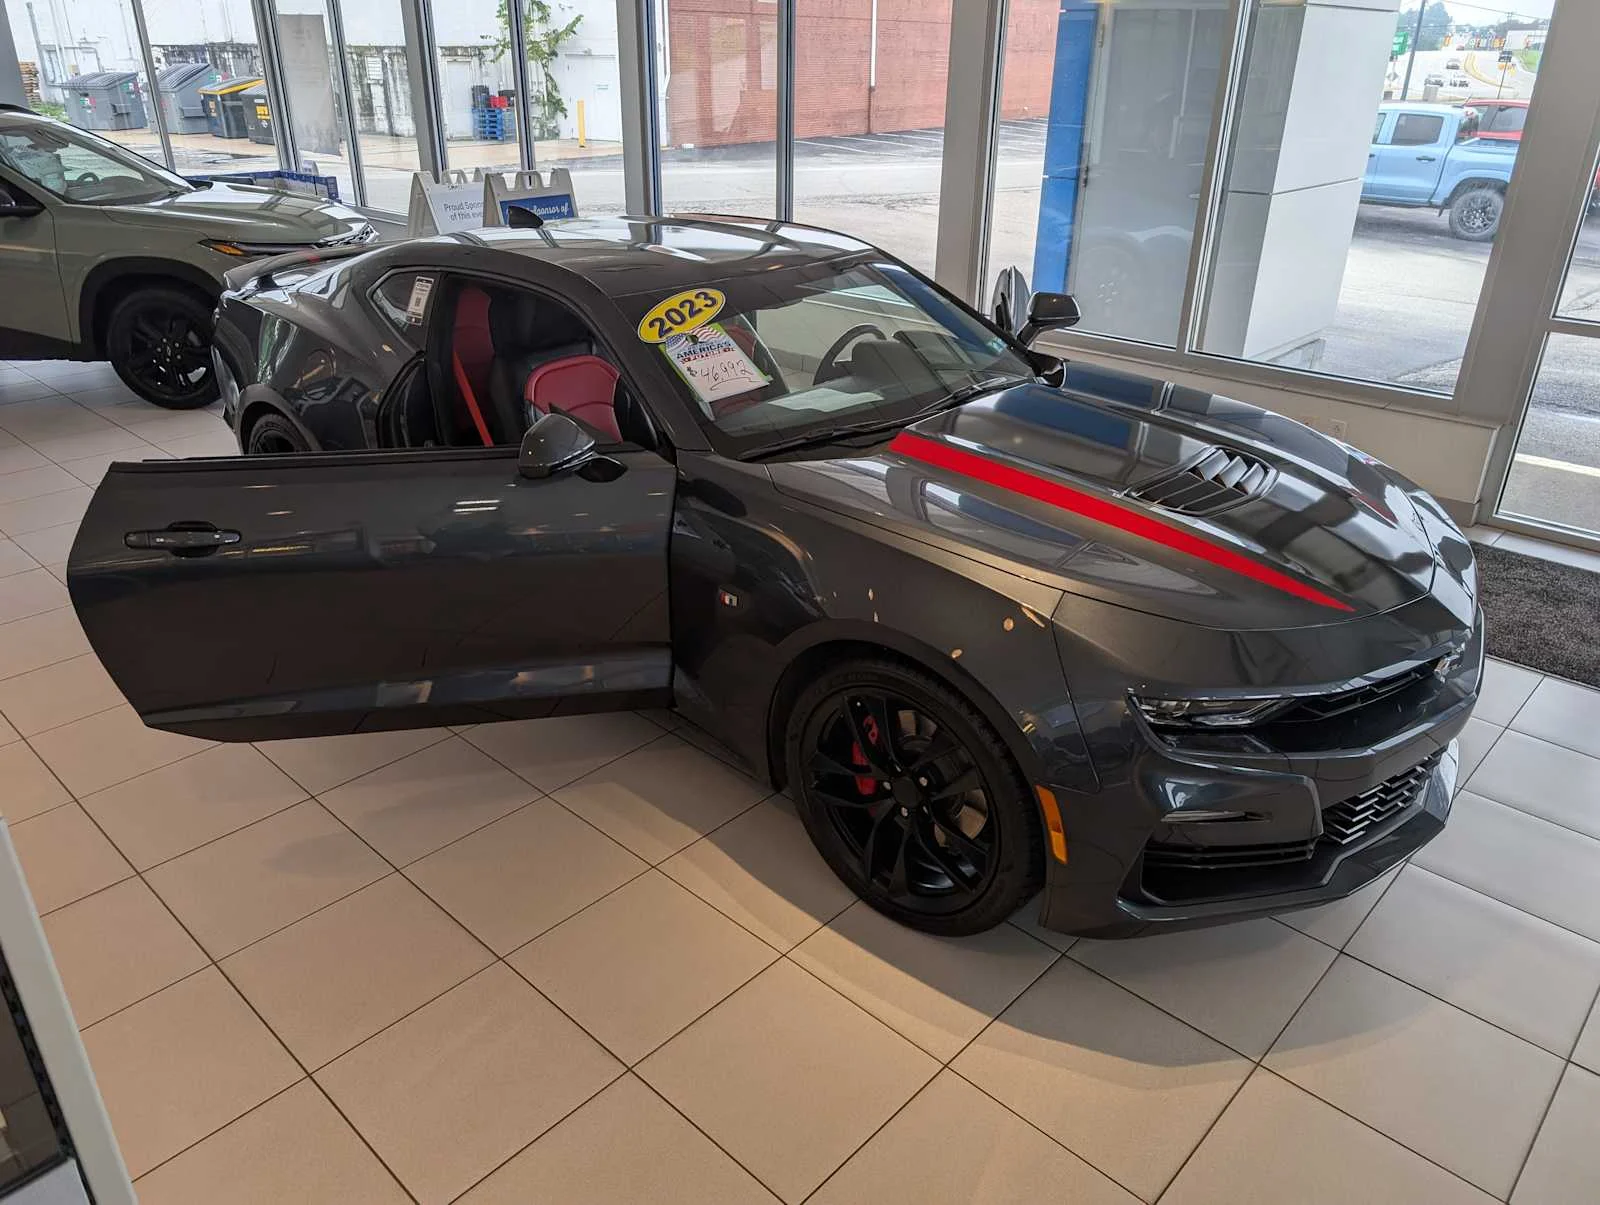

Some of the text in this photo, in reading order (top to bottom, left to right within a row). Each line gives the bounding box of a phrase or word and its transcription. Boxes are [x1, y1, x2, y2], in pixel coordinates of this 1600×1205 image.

[443, 201, 483, 212] Proud Spon
[560, 202, 569, 216] of
[450, 212, 457, 221] of
[458, 211, 471, 220] this
[648, 291, 717, 339] 2023
